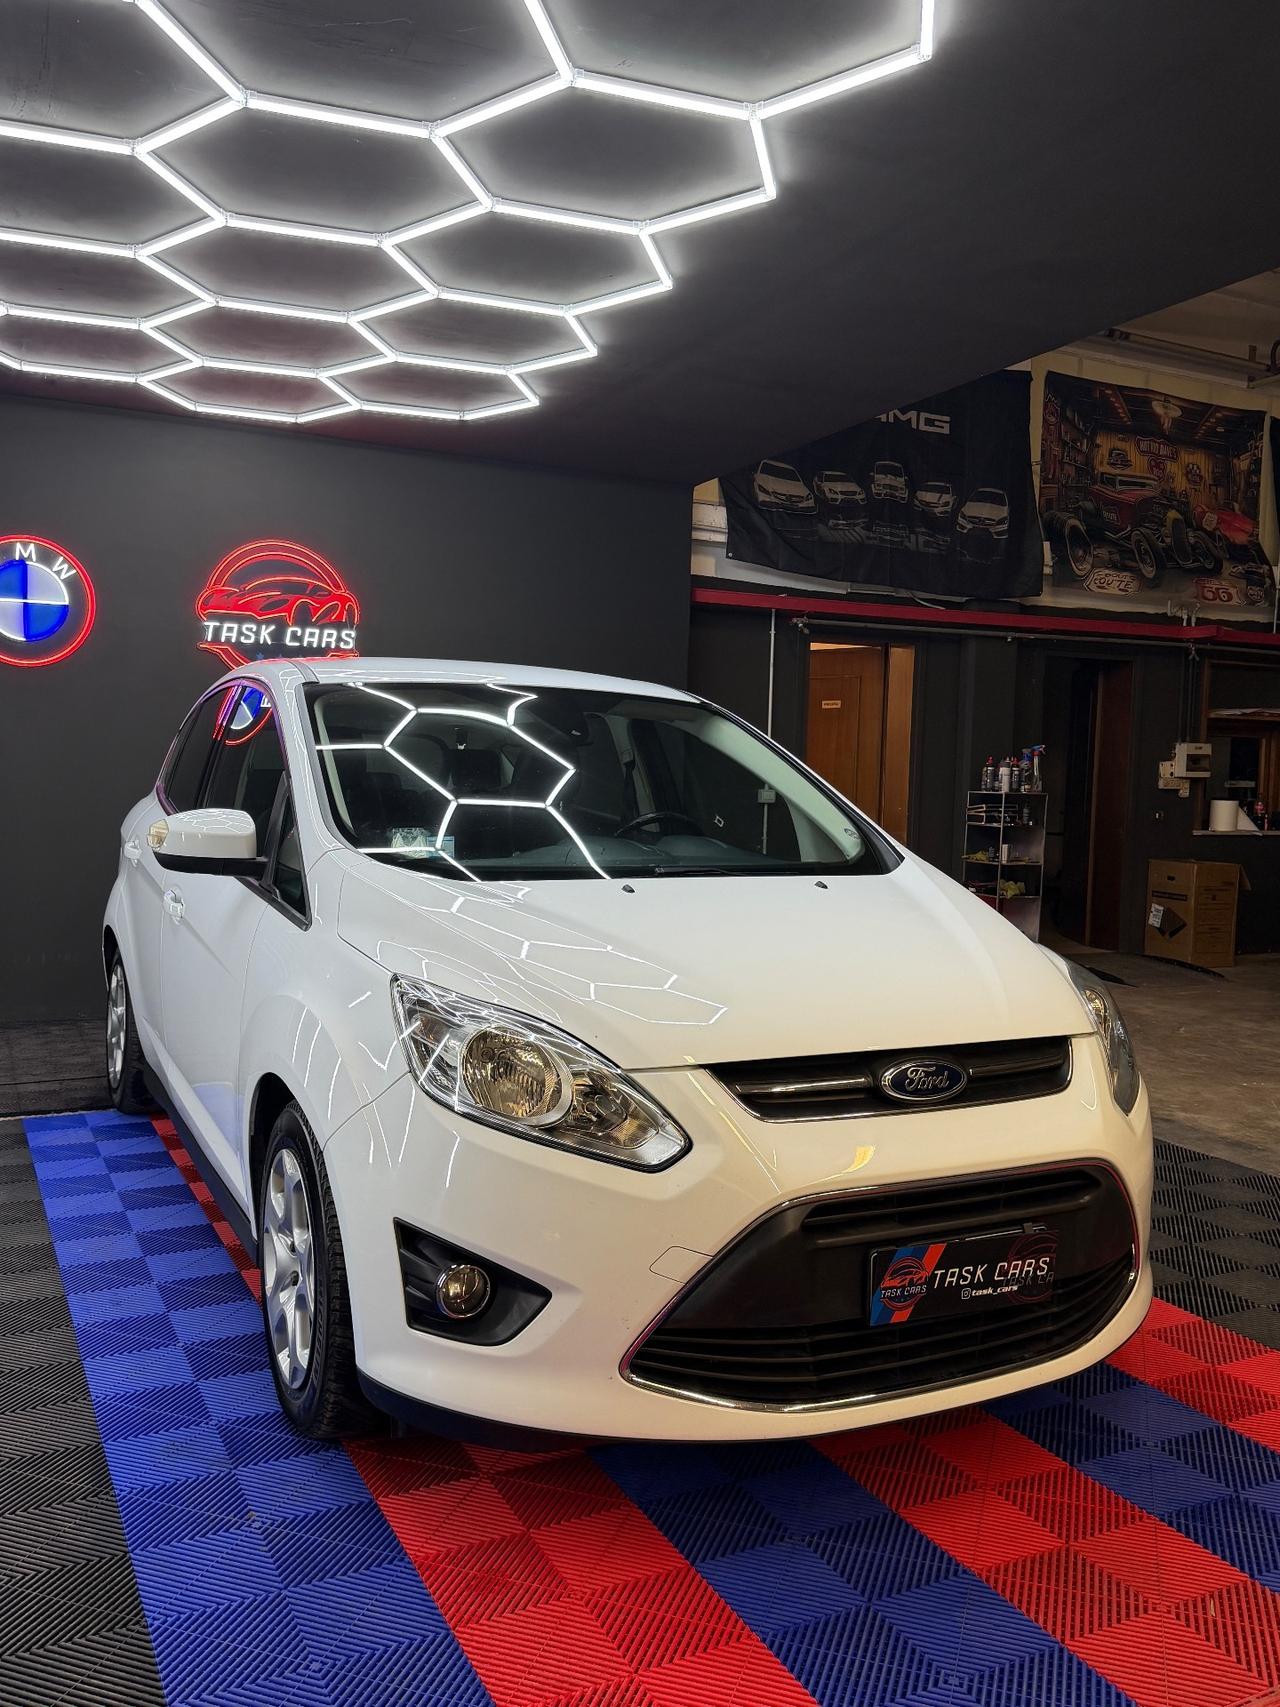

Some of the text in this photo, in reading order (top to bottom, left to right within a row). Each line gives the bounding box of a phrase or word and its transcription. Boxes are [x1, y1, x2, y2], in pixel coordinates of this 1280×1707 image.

[1199, 585, 1233, 602] 66
[203, 622, 356, 649] TASK CARS
[904, 1066, 950, 1092] Ford
[933, 1257, 1050, 1289] TASK CARS
[881, 1284, 927, 1298] TASK CARS
[971, 1284, 1018, 1297] task_cars
